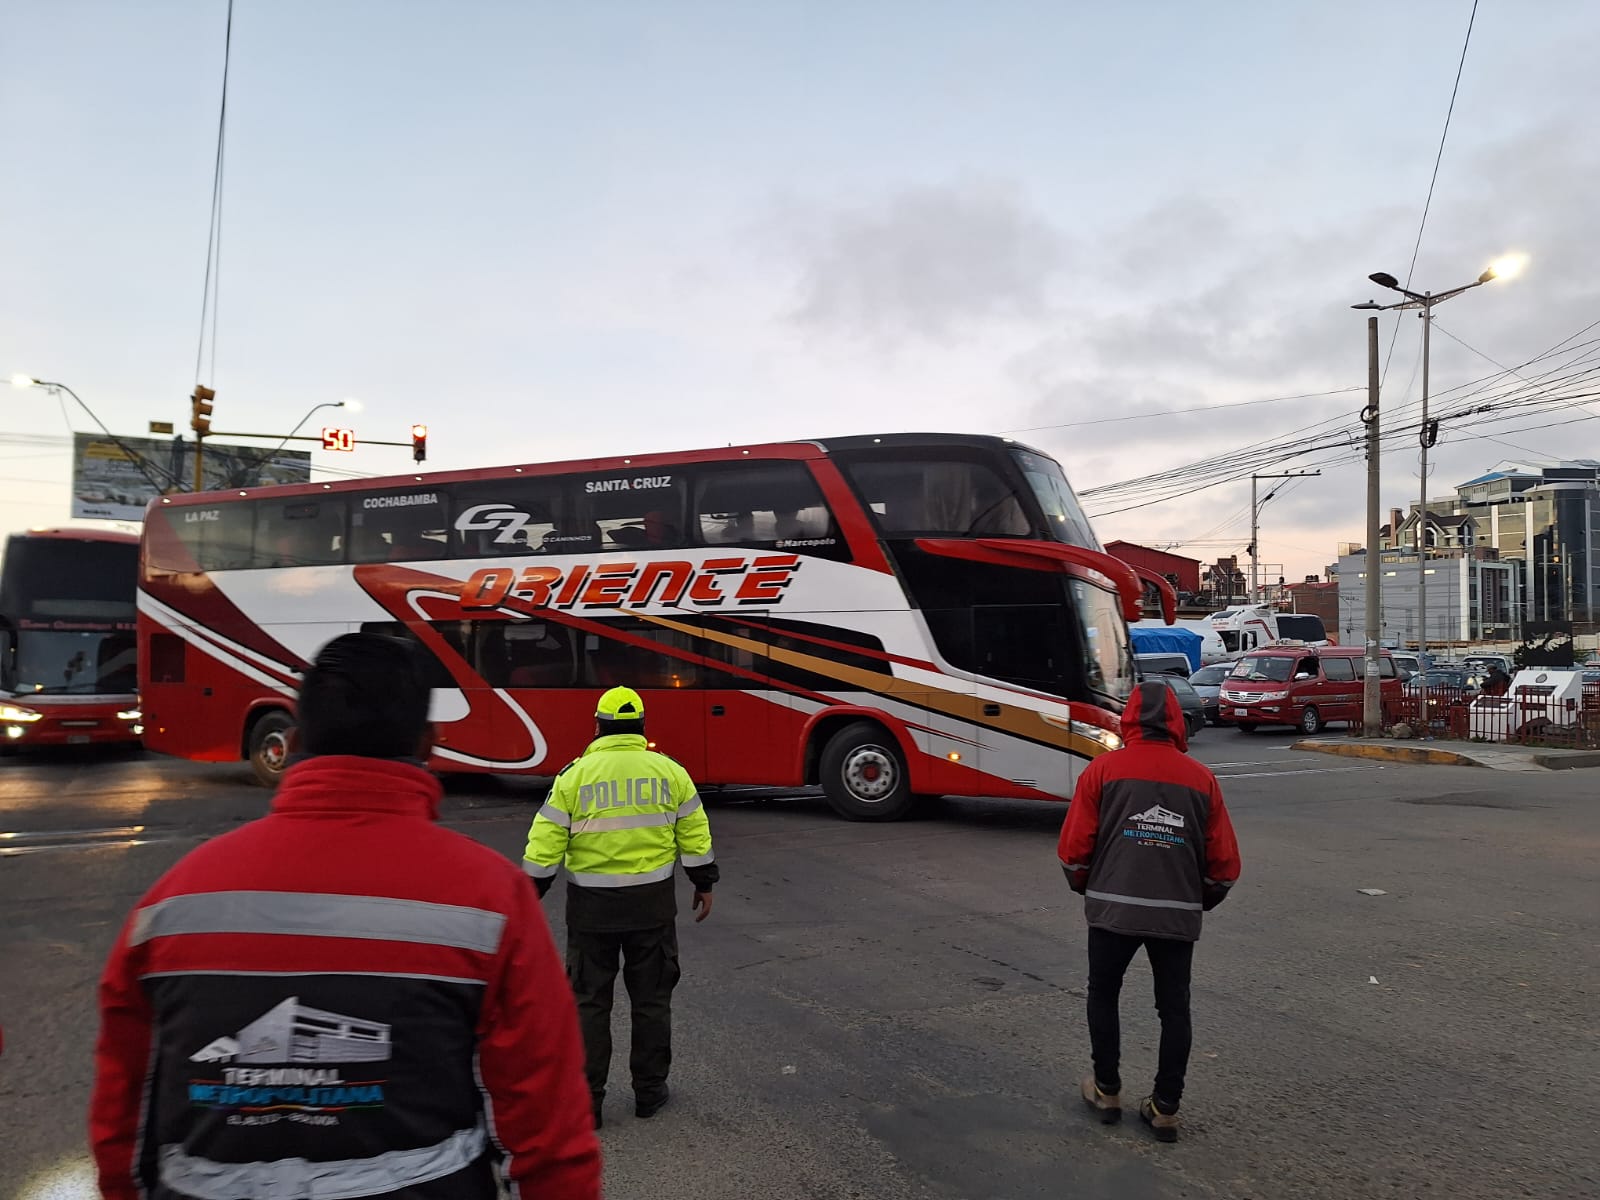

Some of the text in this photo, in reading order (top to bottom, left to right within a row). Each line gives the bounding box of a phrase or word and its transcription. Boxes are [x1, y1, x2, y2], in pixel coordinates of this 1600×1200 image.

[323, 429, 353, 451] 50
[585, 475, 672, 494] SANTA CRUZ
[363, 493, 438, 509] COCHABAMBA
[184, 510, 221, 523] LA PAZ
[783, 538, 836, 547] Marcopolo
[461, 553, 801, 610] ORIENTE
[579, 777, 671, 813] POLICIA
[1123, 828, 1185, 844] METROPOLITANA
[1136, 822, 1174, 834] TERMINAL
[221, 1067, 345, 1086] TERMINAL
